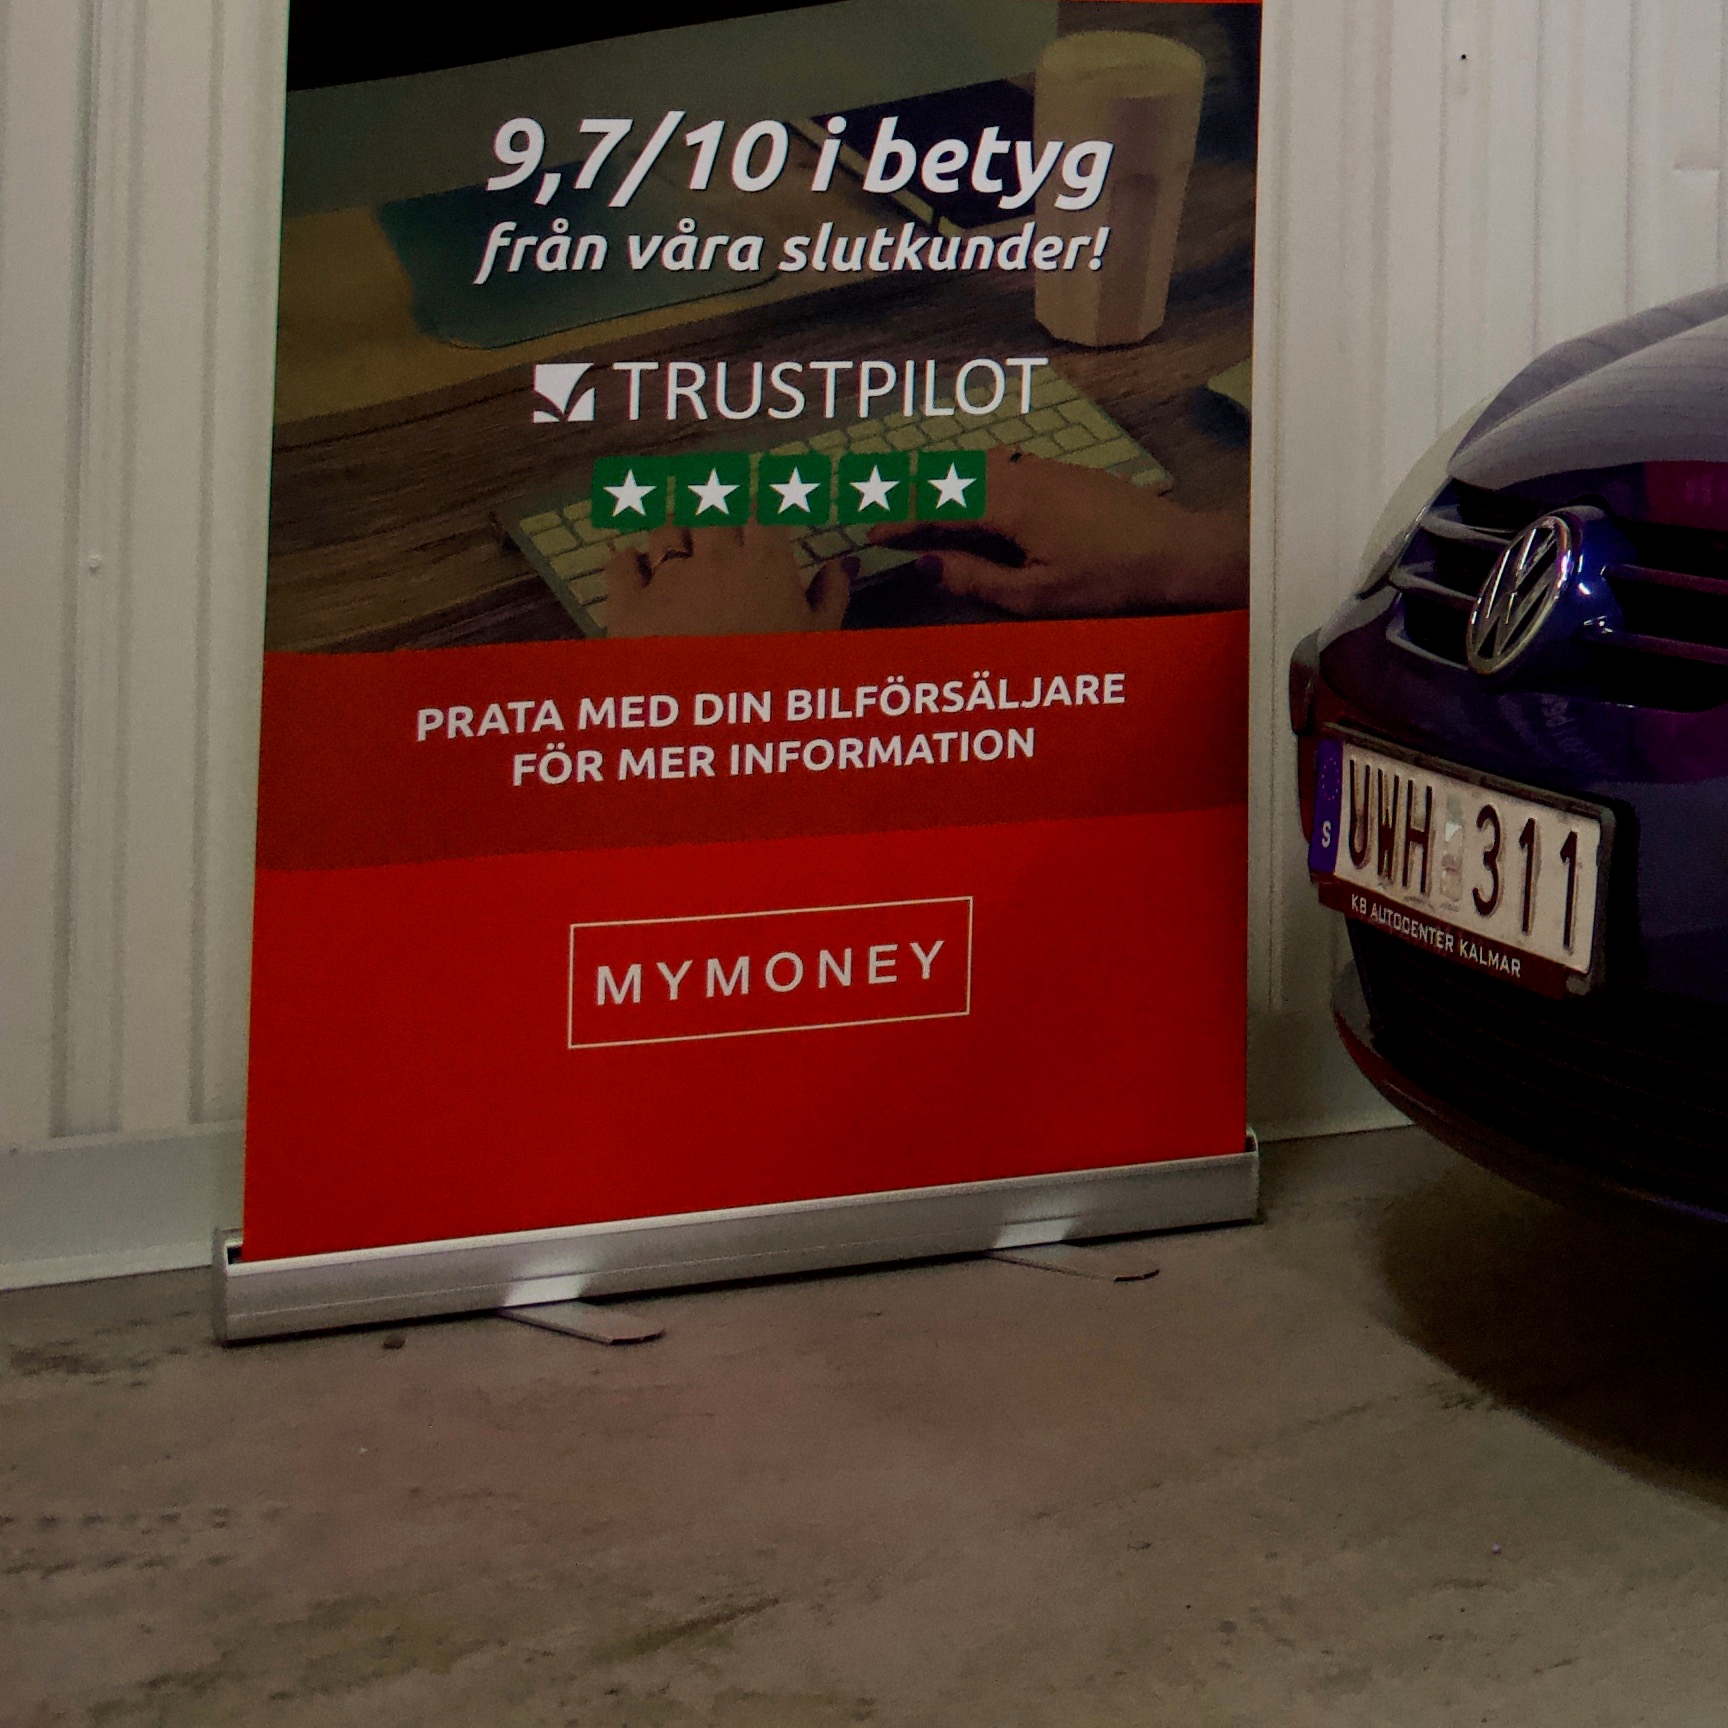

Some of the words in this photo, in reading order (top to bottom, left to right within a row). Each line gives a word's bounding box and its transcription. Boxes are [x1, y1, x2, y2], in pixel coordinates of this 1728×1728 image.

[488, 111, 788, 207] 9,7/10
[812, 120, 841, 191] i
[863, 116, 1113, 210] betyg
[474, 218, 607, 284] från
[629, 218, 763, 270] våra
[779, 221, 1110, 271] slutkunder!
[613, 358, 1048, 420] TRUSTPILOT
[418, 700, 564, 741] PRATA
[578, 695, 678, 729] MED
[695, 691, 771, 725] DIN
[788, 671, 1125, 721] BILFÖRSÄLJARE
[513, 742, 603, 786] FÖR
[619, 746, 715, 780] MER
[731, 728, 1034, 775] INFORMATION
[1349, 759, 1433, 894] UWH
[1472, 804, 1578, 955] 311
[1351, 894, 1367, 916] KB
[1370, 904, 1454, 953] AUTOCENTER
[1459, 940, 1521, 977] KALMAR
[597, 940, 944, 1005] MYMONEY
